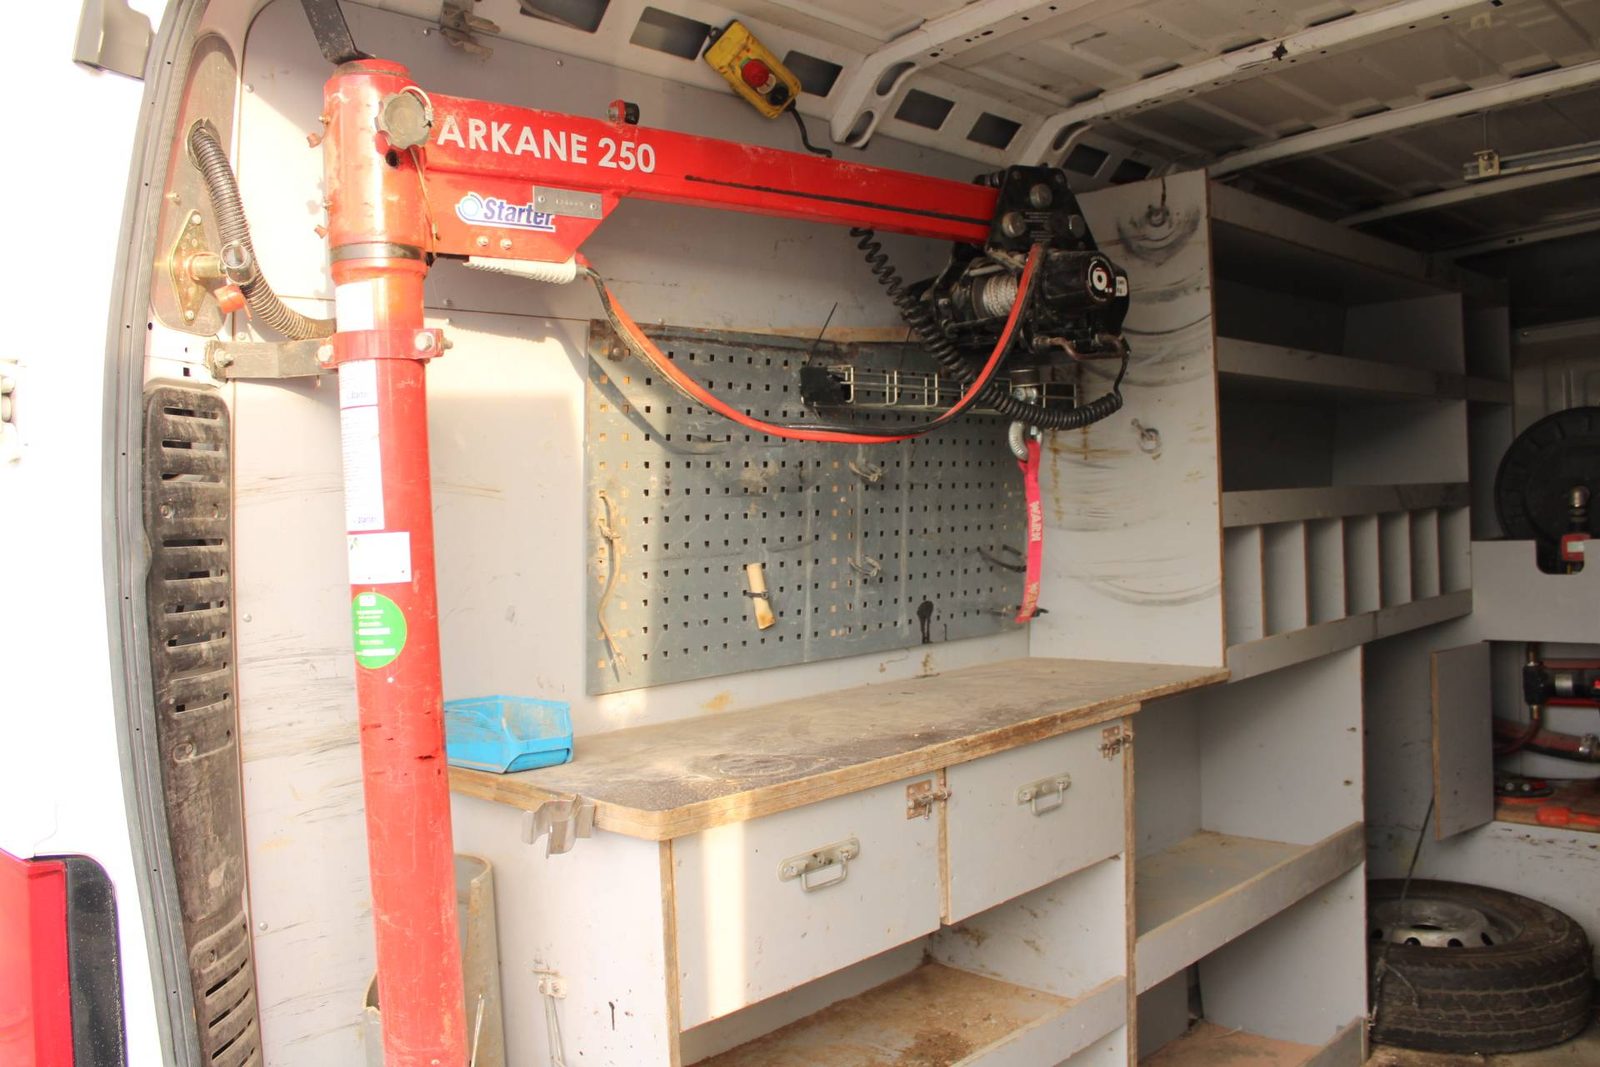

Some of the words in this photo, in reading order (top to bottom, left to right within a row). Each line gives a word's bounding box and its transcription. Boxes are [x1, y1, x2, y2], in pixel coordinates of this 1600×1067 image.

[437, 114, 588, 165] ARKANE
[598, 137, 656, 173] 250
[483, 198, 553, 226] Starter
[1029, 500, 1042, 542] WARN
